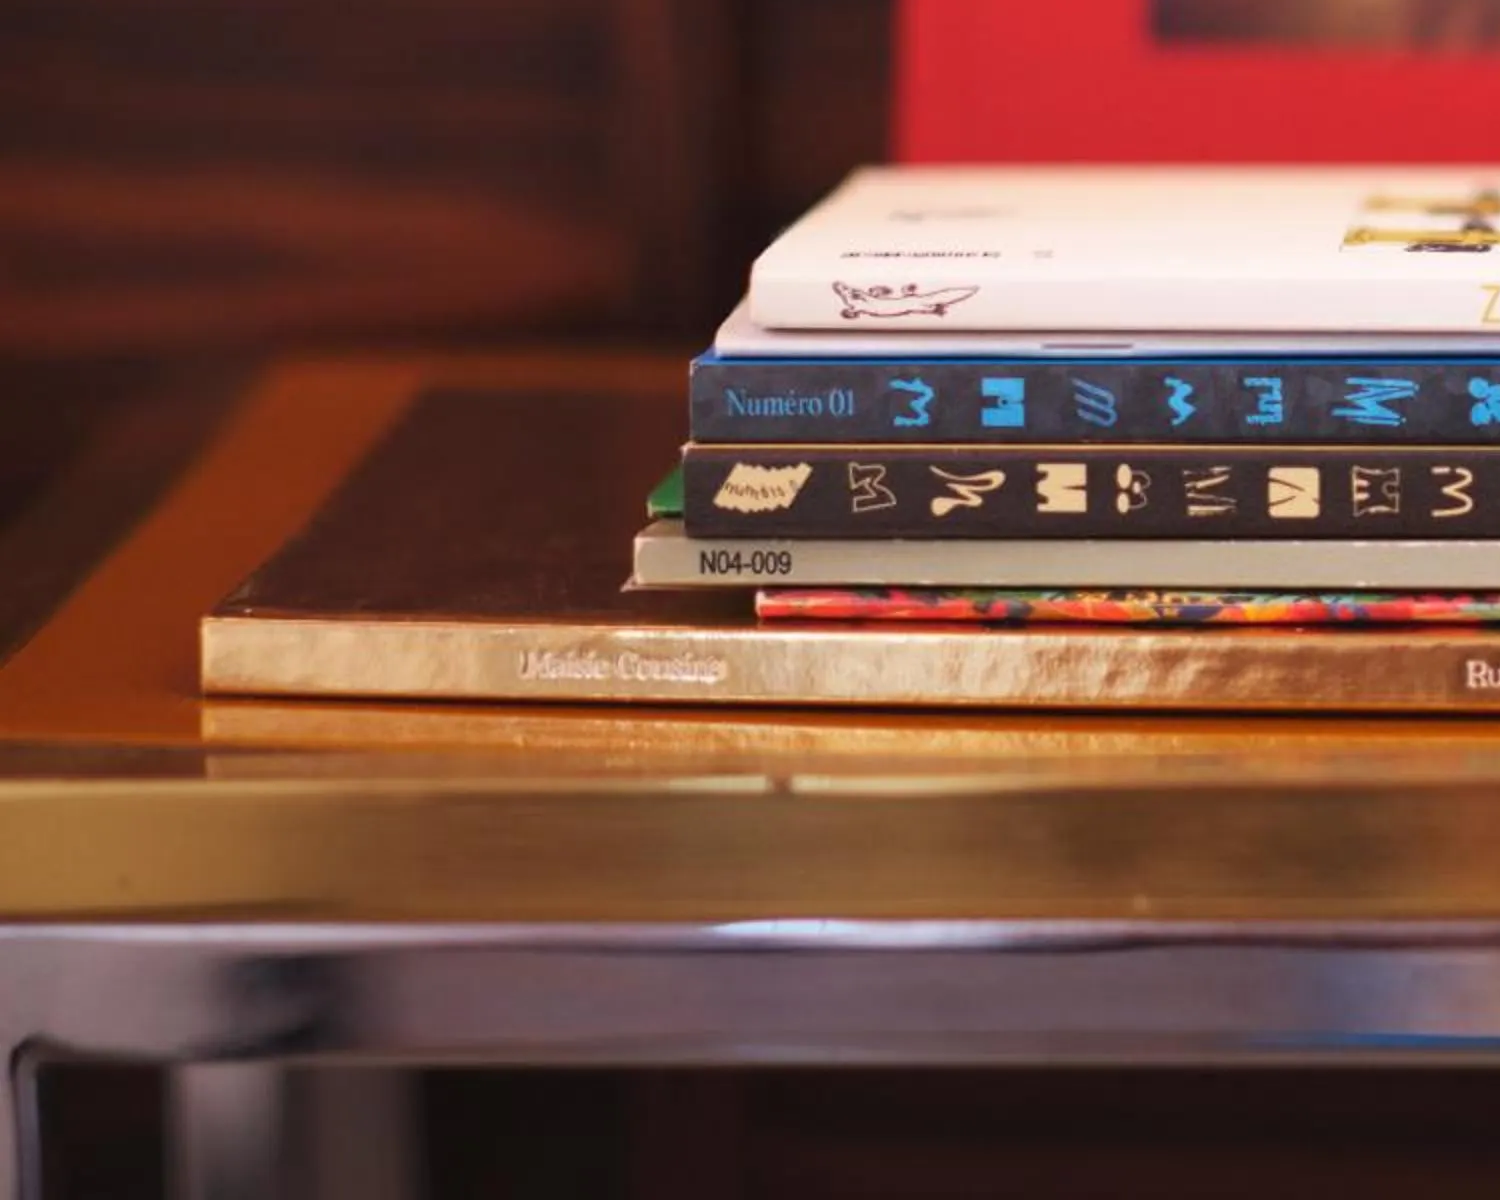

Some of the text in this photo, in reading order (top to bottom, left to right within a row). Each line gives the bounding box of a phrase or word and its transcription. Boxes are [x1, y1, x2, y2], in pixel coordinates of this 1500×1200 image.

[724, 387, 854, 417] Numéro 01
[699, 551, 792, 575] N04-009
